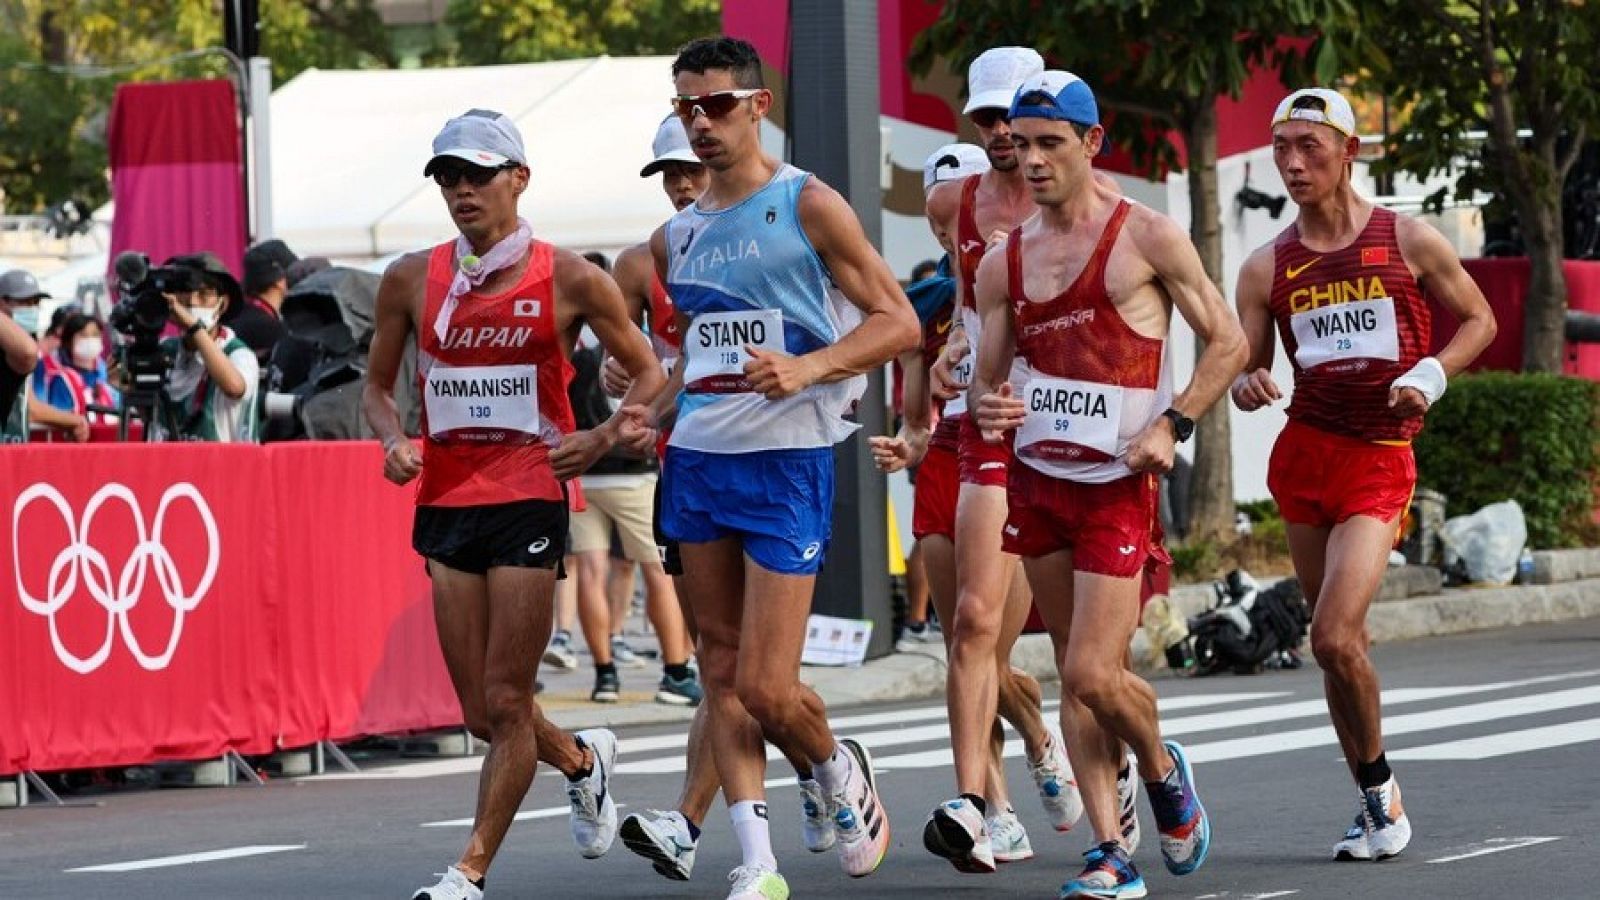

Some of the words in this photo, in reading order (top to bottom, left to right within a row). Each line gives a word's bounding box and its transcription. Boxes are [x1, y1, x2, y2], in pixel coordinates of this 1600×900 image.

[690, 239, 760, 280] ITALIA
[1289, 275, 1387, 313] CHINA
[698, 319, 765, 348] STANO
[1310, 308, 1376, 338] WANG
[438, 326, 533, 350] JAPAN
[721, 352, 738, 364] 118
[430, 377, 530, 398] YAMANISHI
[468, 405, 491, 418] 130
[1030, 387, 1108, 419] GARCIA
[1053, 419, 1069, 431] 59
